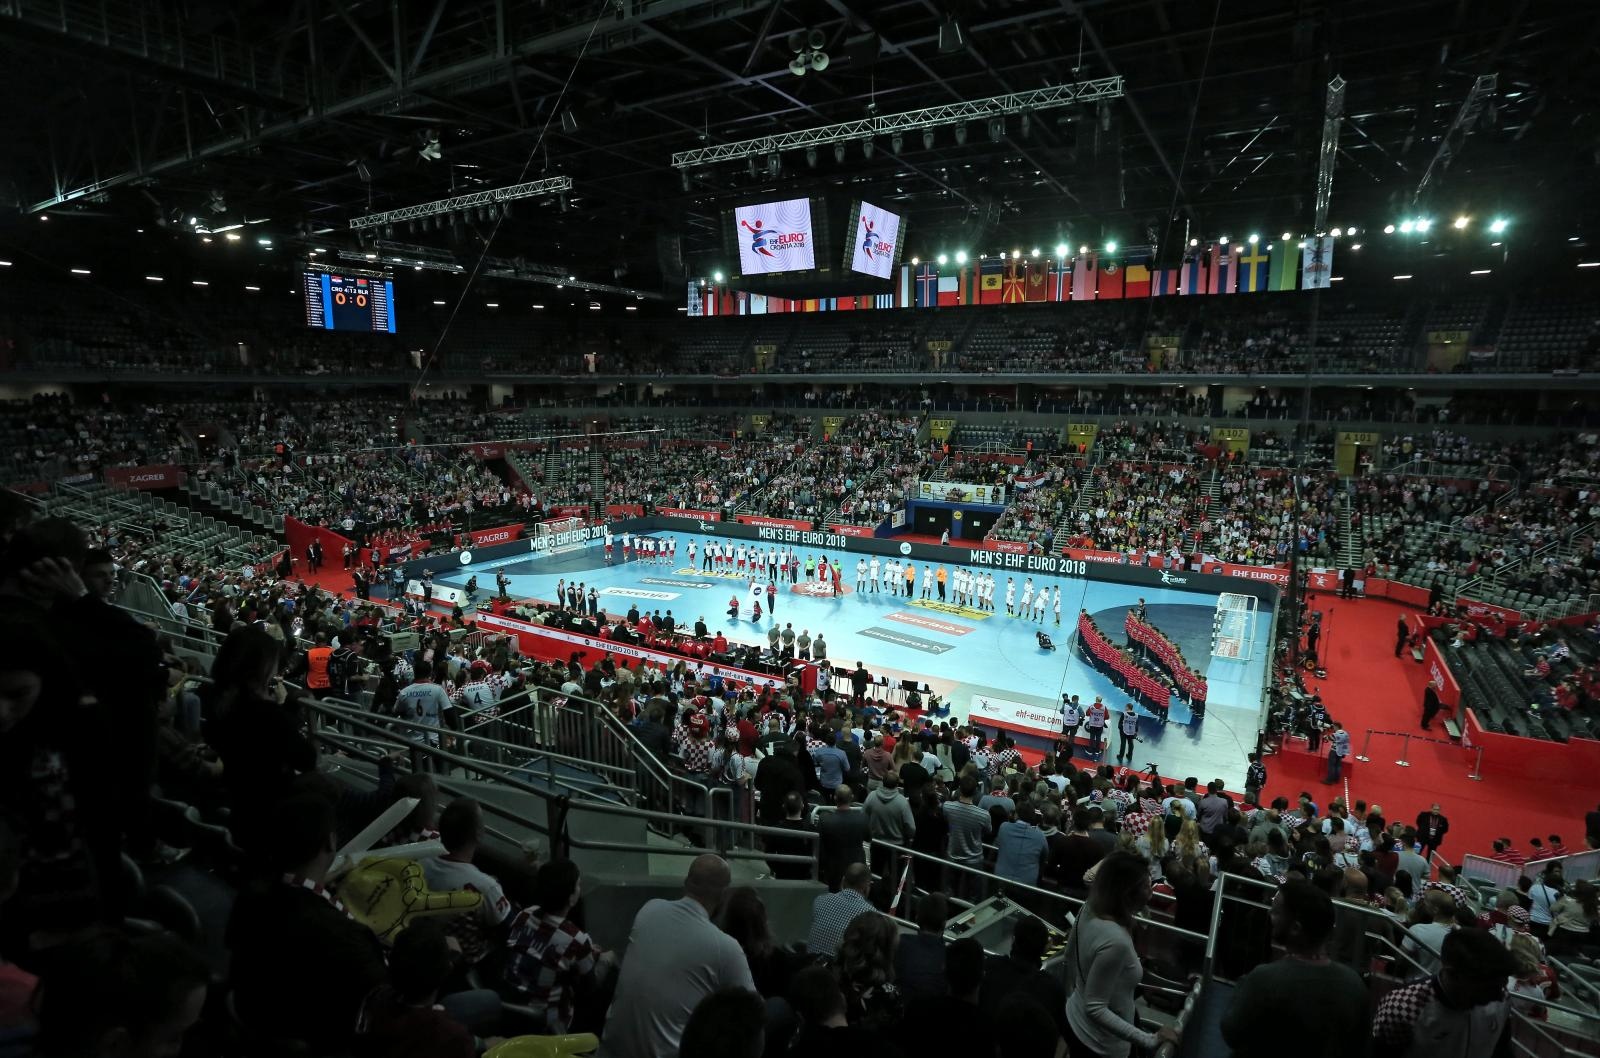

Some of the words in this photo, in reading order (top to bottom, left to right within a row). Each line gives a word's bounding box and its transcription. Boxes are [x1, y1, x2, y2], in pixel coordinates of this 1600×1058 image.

[778, 234, 804, 244] EURO
[336, 292, 346, 305] 0
[356, 294, 366, 306] 0
[1072, 424, 1078, 432] A
[130, 474, 165, 482] ZAGREB
[478, 532, 508, 544] ZAGREB
[556, 530, 571, 545] EHF
[592, 524, 608, 537] 2018
[759, 527, 783, 540] MEN'S
[786, 530, 800, 542] EHF
[803, 532, 824, 544] EURO
[826, 534, 846, 547] 2018
[970, 550, 1002, 565] MEN'S
[1006, 553, 1024, 568] EHF
[1028, 556, 1056, 571] EURO
[1060, 560, 1086, 574] 2018
[1232, 570, 1249, 578] EHF
[1250, 572, 1276, 580] EURO
[1278, 574, 1289, 582] 20
[606, 644, 622, 652] EURO
[624, 648, 638, 656] 2018
[474, 692, 482, 704] 4
[416, 698, 424, 717] 6
[1016, 710, 1062, 725] ehf-euro.com
